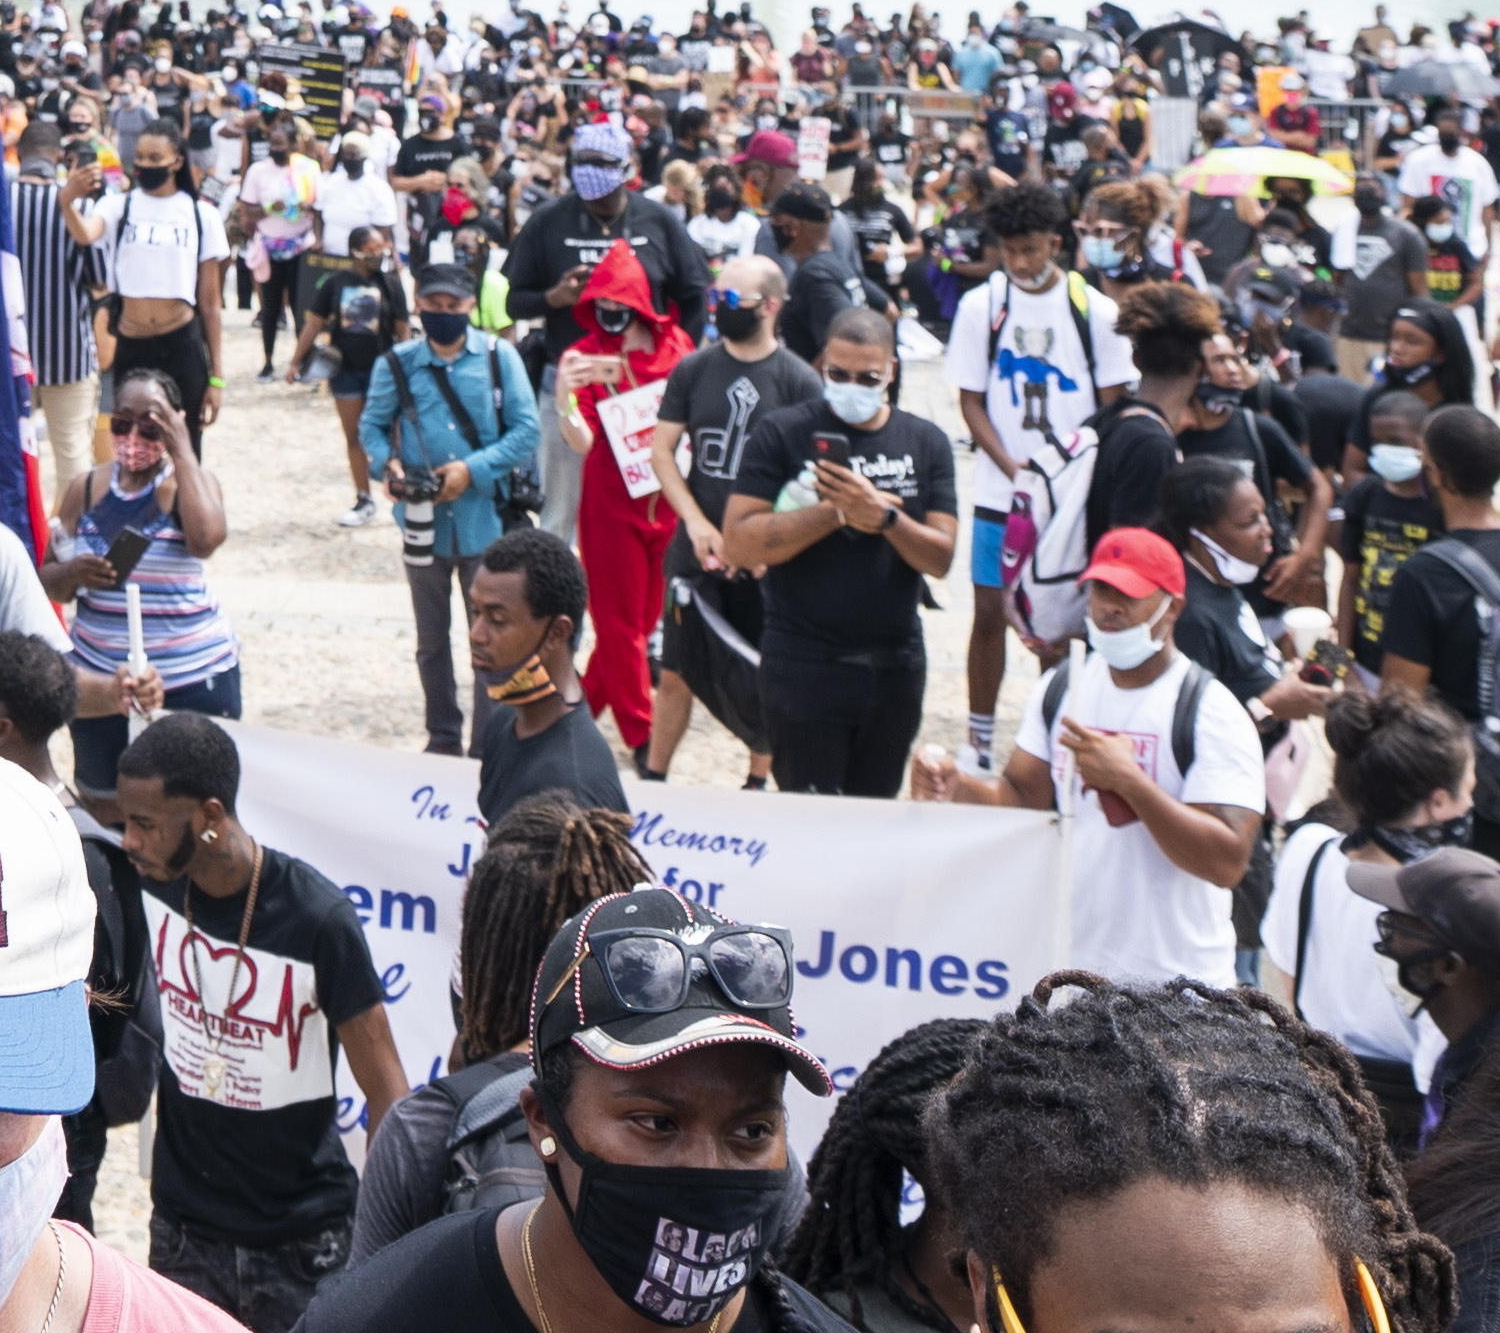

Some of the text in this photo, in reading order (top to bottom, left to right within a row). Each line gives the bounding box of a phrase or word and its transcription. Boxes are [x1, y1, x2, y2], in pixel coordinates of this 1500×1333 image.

[848, 452, 916, 481] Today!
[411, 784, 769, 868] In Memory
[661, 867, 726, 908] for
[795, 930, 1010, 1000] Jones
[648, 1247, 750, 1297] LIVES
